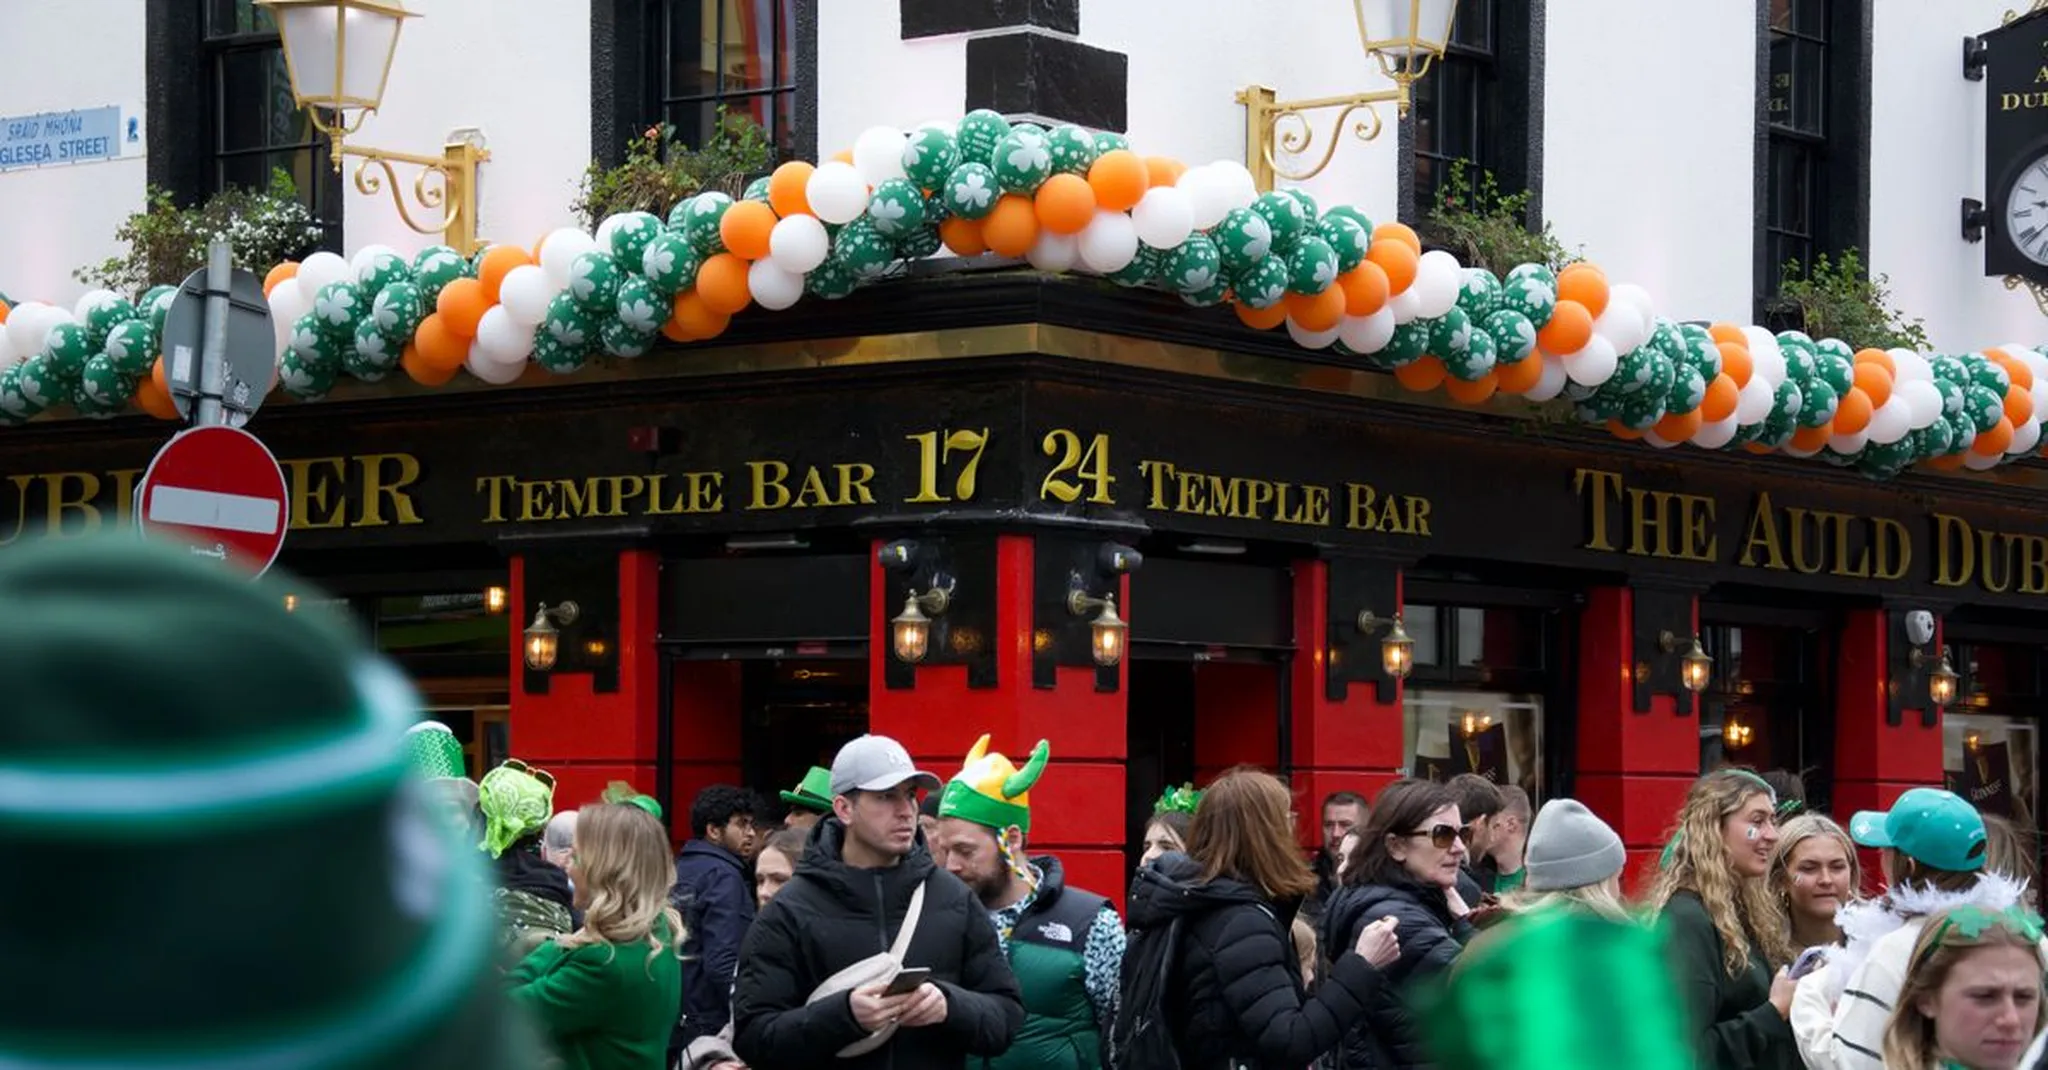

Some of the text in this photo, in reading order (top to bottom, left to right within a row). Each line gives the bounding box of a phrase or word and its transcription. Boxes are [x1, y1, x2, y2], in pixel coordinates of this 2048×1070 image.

[59, 136, 110, 159] STREET
[477, 427, 989, 522] TEMPLE BAR 17
[1041, 429, 1432, 537] 24 TEMPLE BAR
[1573, 468, 2048, 594] THE AULD DUB
